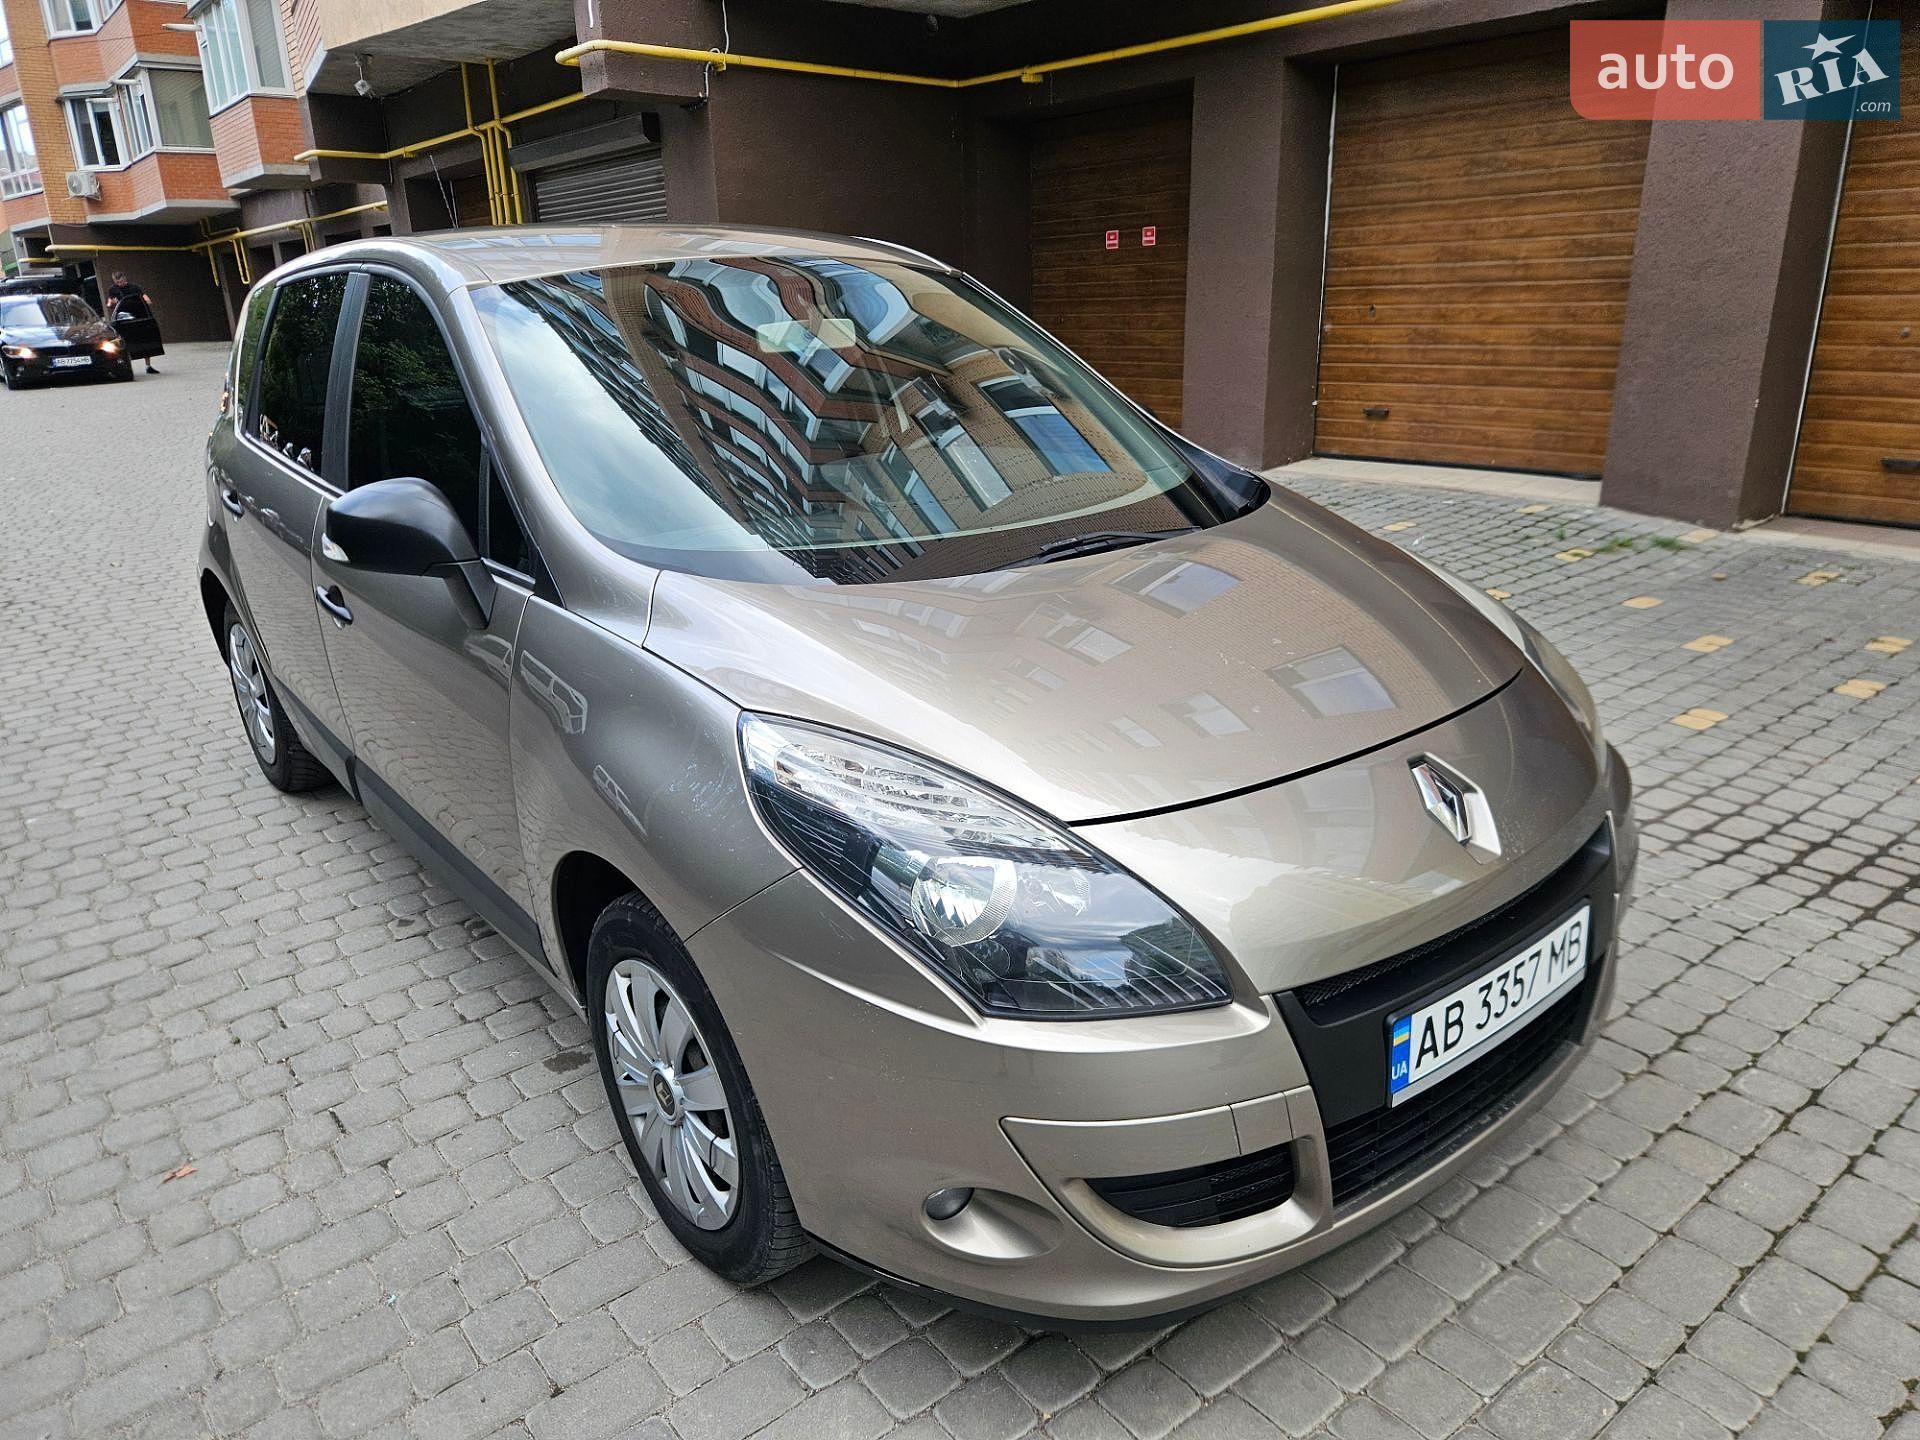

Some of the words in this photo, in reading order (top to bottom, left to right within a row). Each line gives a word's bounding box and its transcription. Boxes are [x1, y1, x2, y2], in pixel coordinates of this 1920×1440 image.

[1415, 1000, 1464, 1070] AB
[1476, 949, 1542, 1030] 3357
[1548, 920, 1582, 983] MB
[1392, 1061, 1407, 1080] UA
